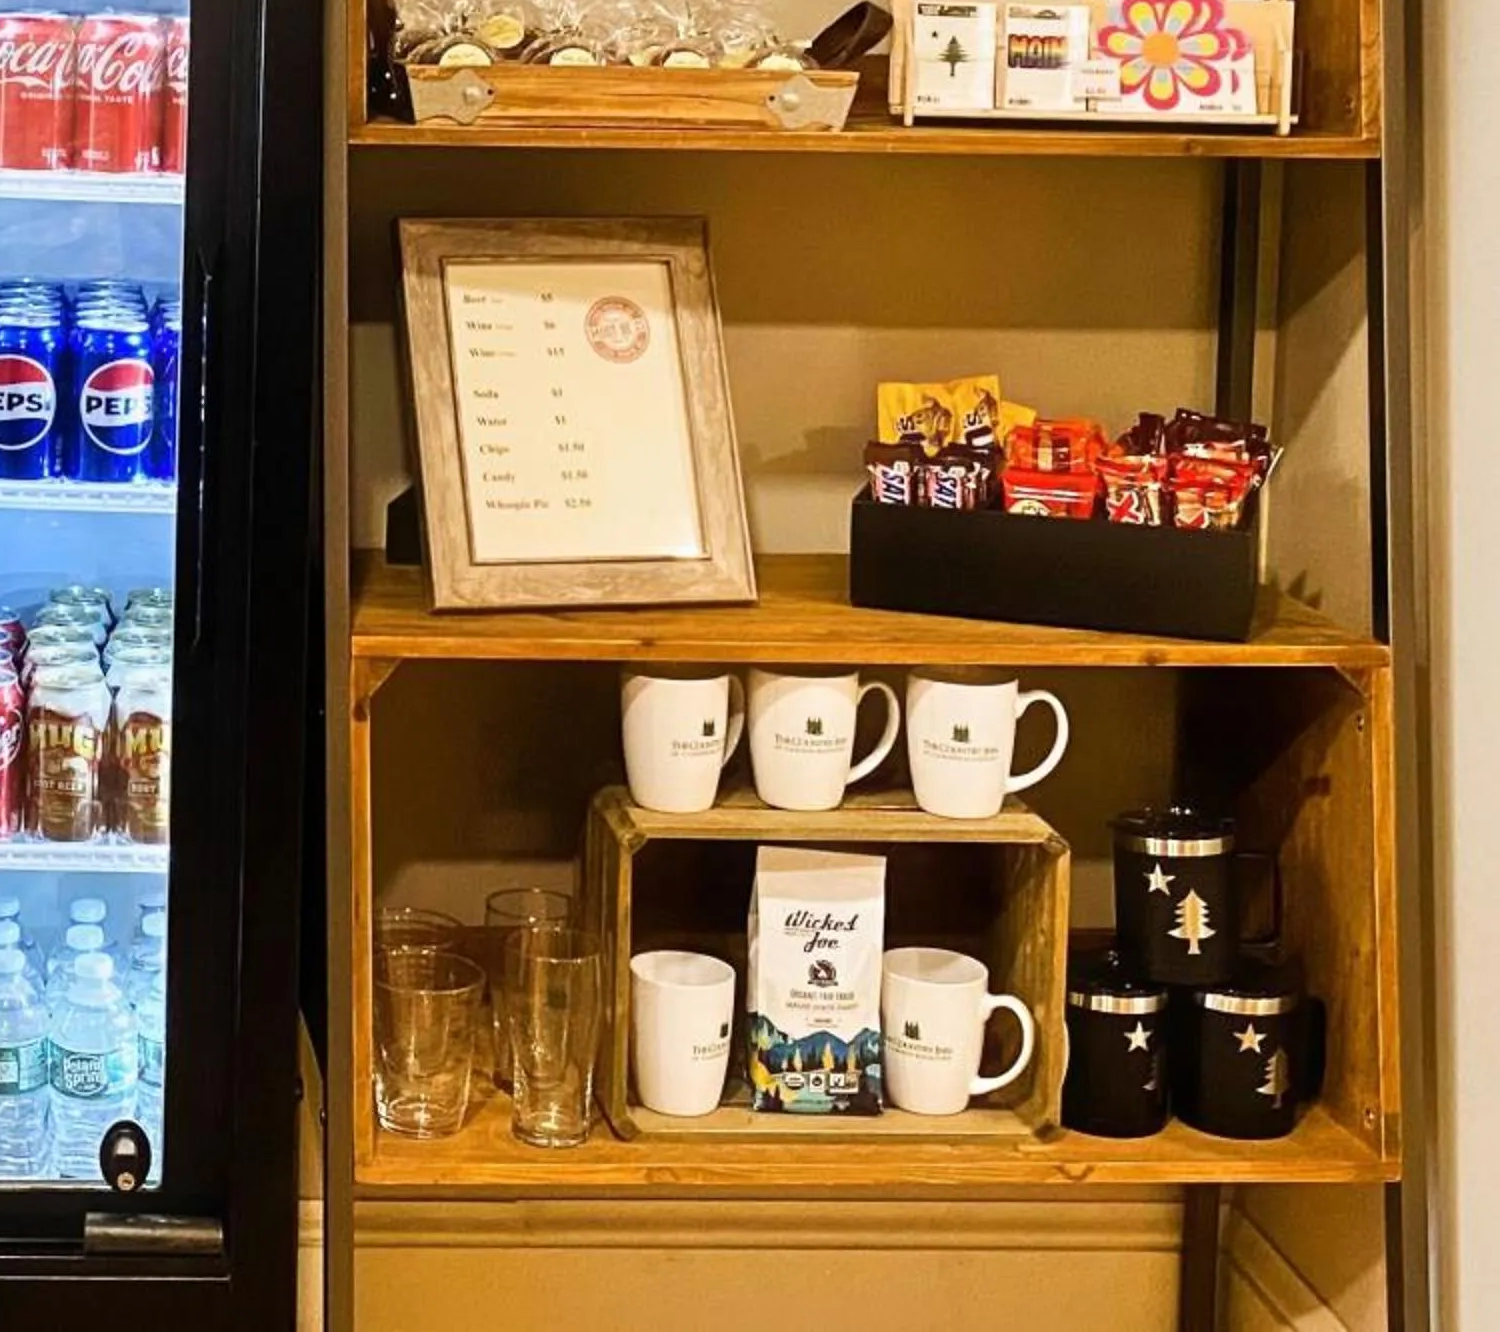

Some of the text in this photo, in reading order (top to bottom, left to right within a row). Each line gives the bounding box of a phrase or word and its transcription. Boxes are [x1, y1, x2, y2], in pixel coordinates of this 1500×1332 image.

[465, 320, 492, 331] Wine
[473, 389, 499, 399] Soda
[479, 445, 511, 456] Chips
[482, 472, 516, 484] Candy
[784, 910, 859, 931] Wicked
[803, 931, 840, 953] Joe
